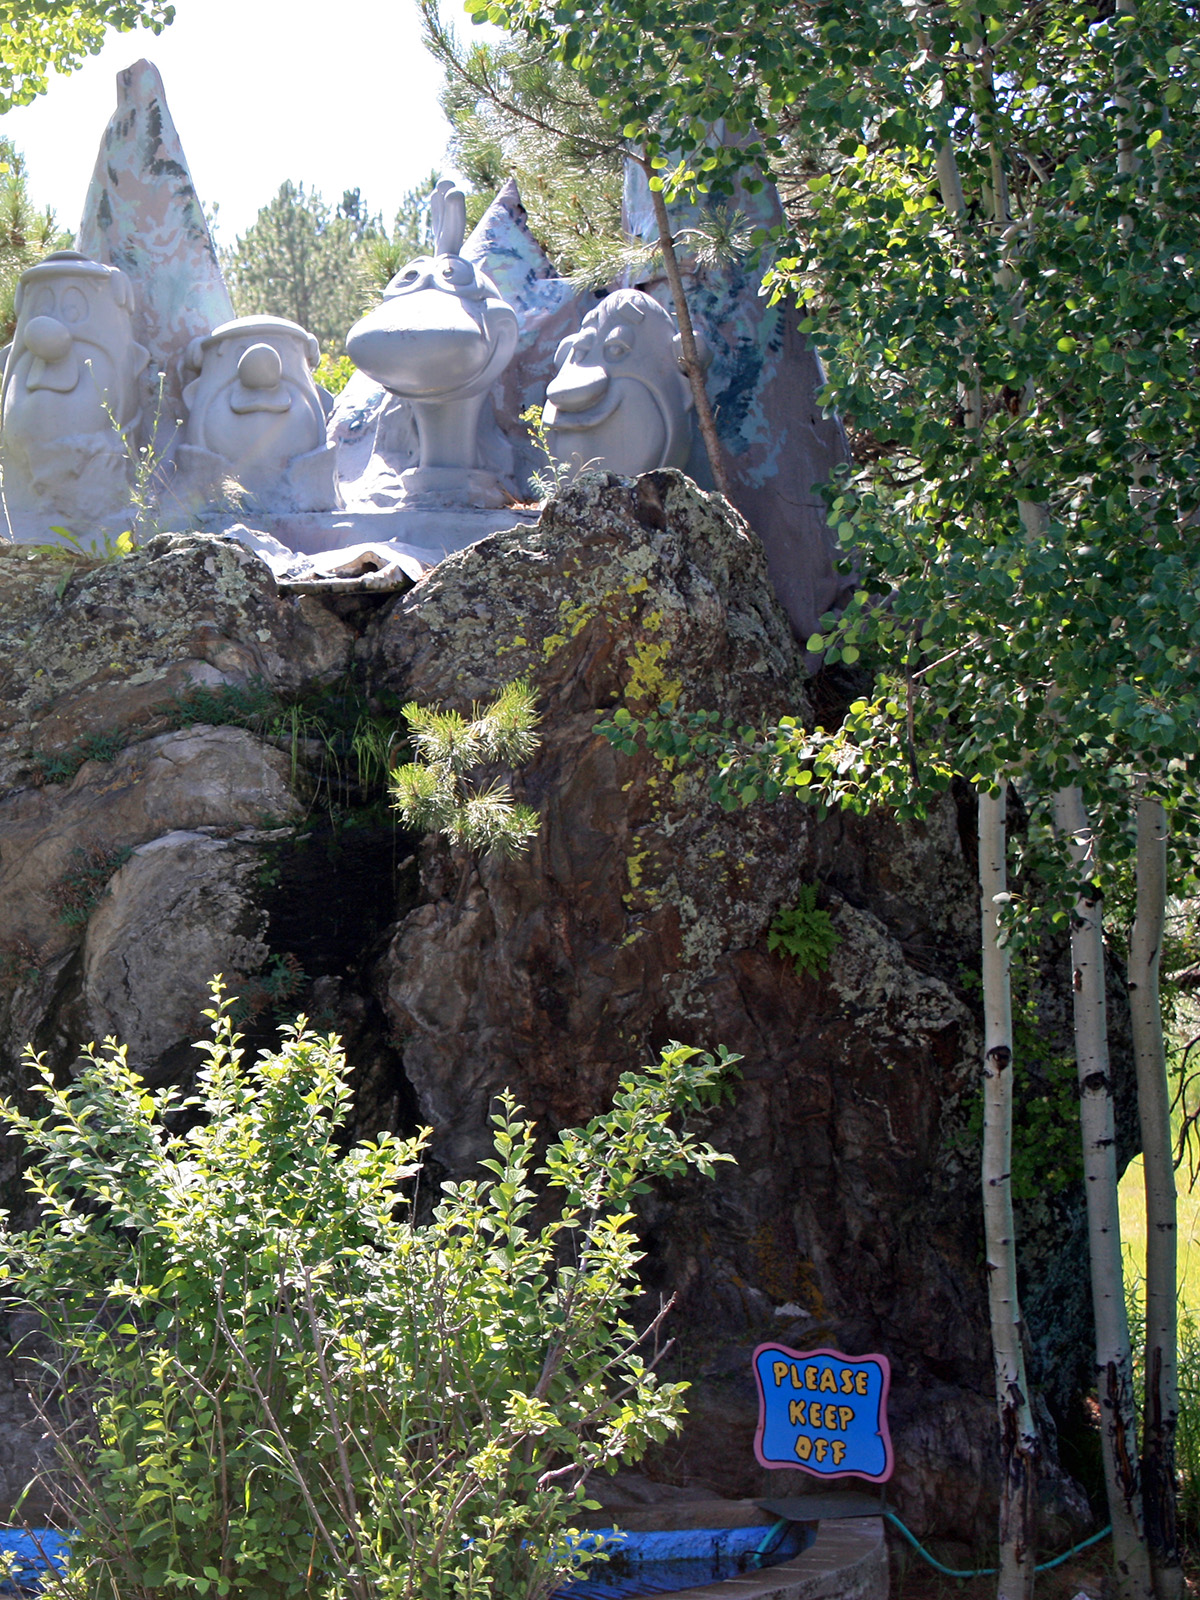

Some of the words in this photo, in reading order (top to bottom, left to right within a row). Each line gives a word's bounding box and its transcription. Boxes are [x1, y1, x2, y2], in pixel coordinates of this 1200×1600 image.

[773, 1361, 869, 1395] PLEASE
[788, 1399, 855, 1431] KEEP
[794, 1435, 846, 1465] OFF
